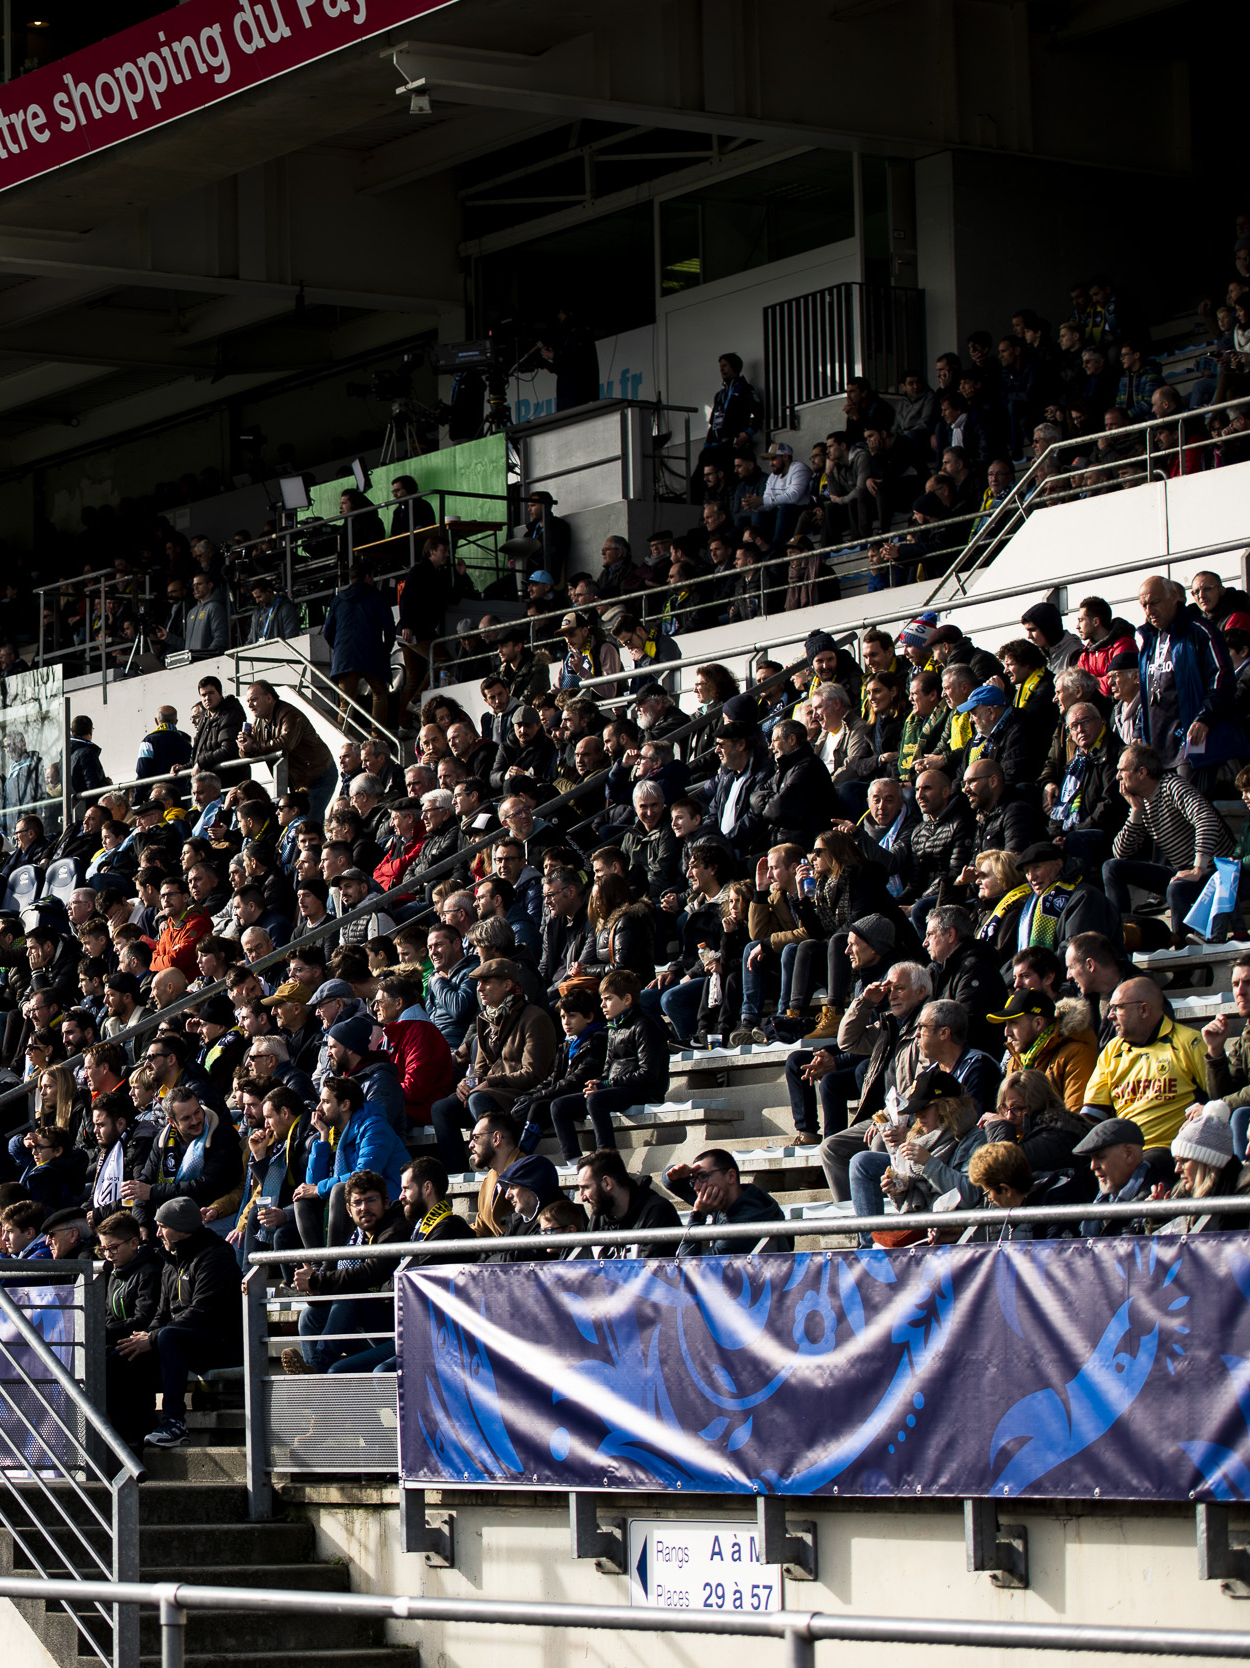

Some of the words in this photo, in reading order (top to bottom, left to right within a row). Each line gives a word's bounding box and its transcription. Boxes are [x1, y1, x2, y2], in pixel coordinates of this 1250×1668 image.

[53, 22, 231, 133] shopping
[232, 0, 292, 56] du
[656, 1540, 690, 1569] Rangs
[710, 1535, 725, 1562] A
[731, 1533, 742, 1562] à
[656, 1584, 690, 1608] Places
[702, 1582, 726, 1609] 29
[732, 1581, 744, 1609] à
[751, 1584, 773, 1611] 57
